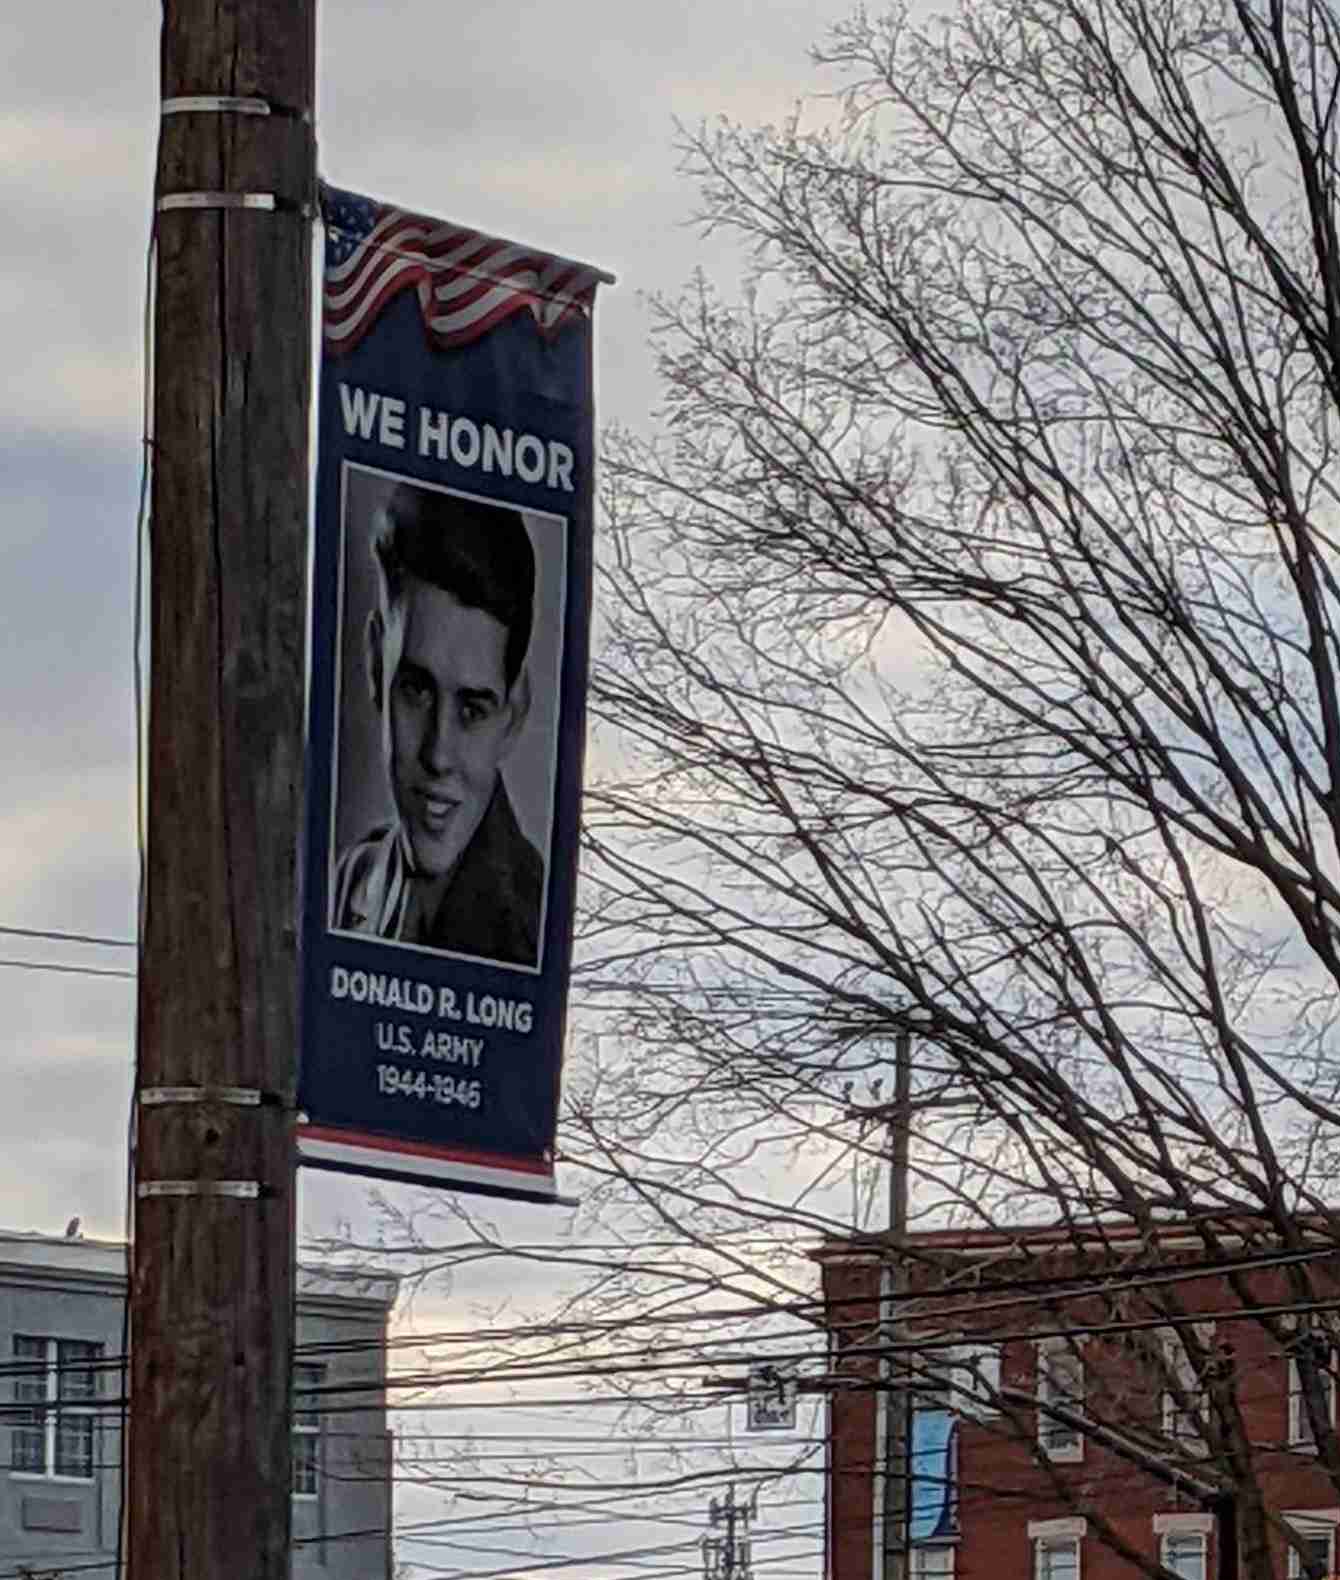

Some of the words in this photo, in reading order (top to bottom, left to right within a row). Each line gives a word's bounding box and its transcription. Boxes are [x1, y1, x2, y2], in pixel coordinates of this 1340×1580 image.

[339, 382, 406, 449] WE
[418, 406, 575, 492] HONOR
[331, 965, 434, 1014] DONALD
[439, 987, 462, 1020] R.
[466, 992, 533, 1033] LONG
[376, 1022, 416, 1056] U.S.
[421, 1029, 484, 1067] ARMY
